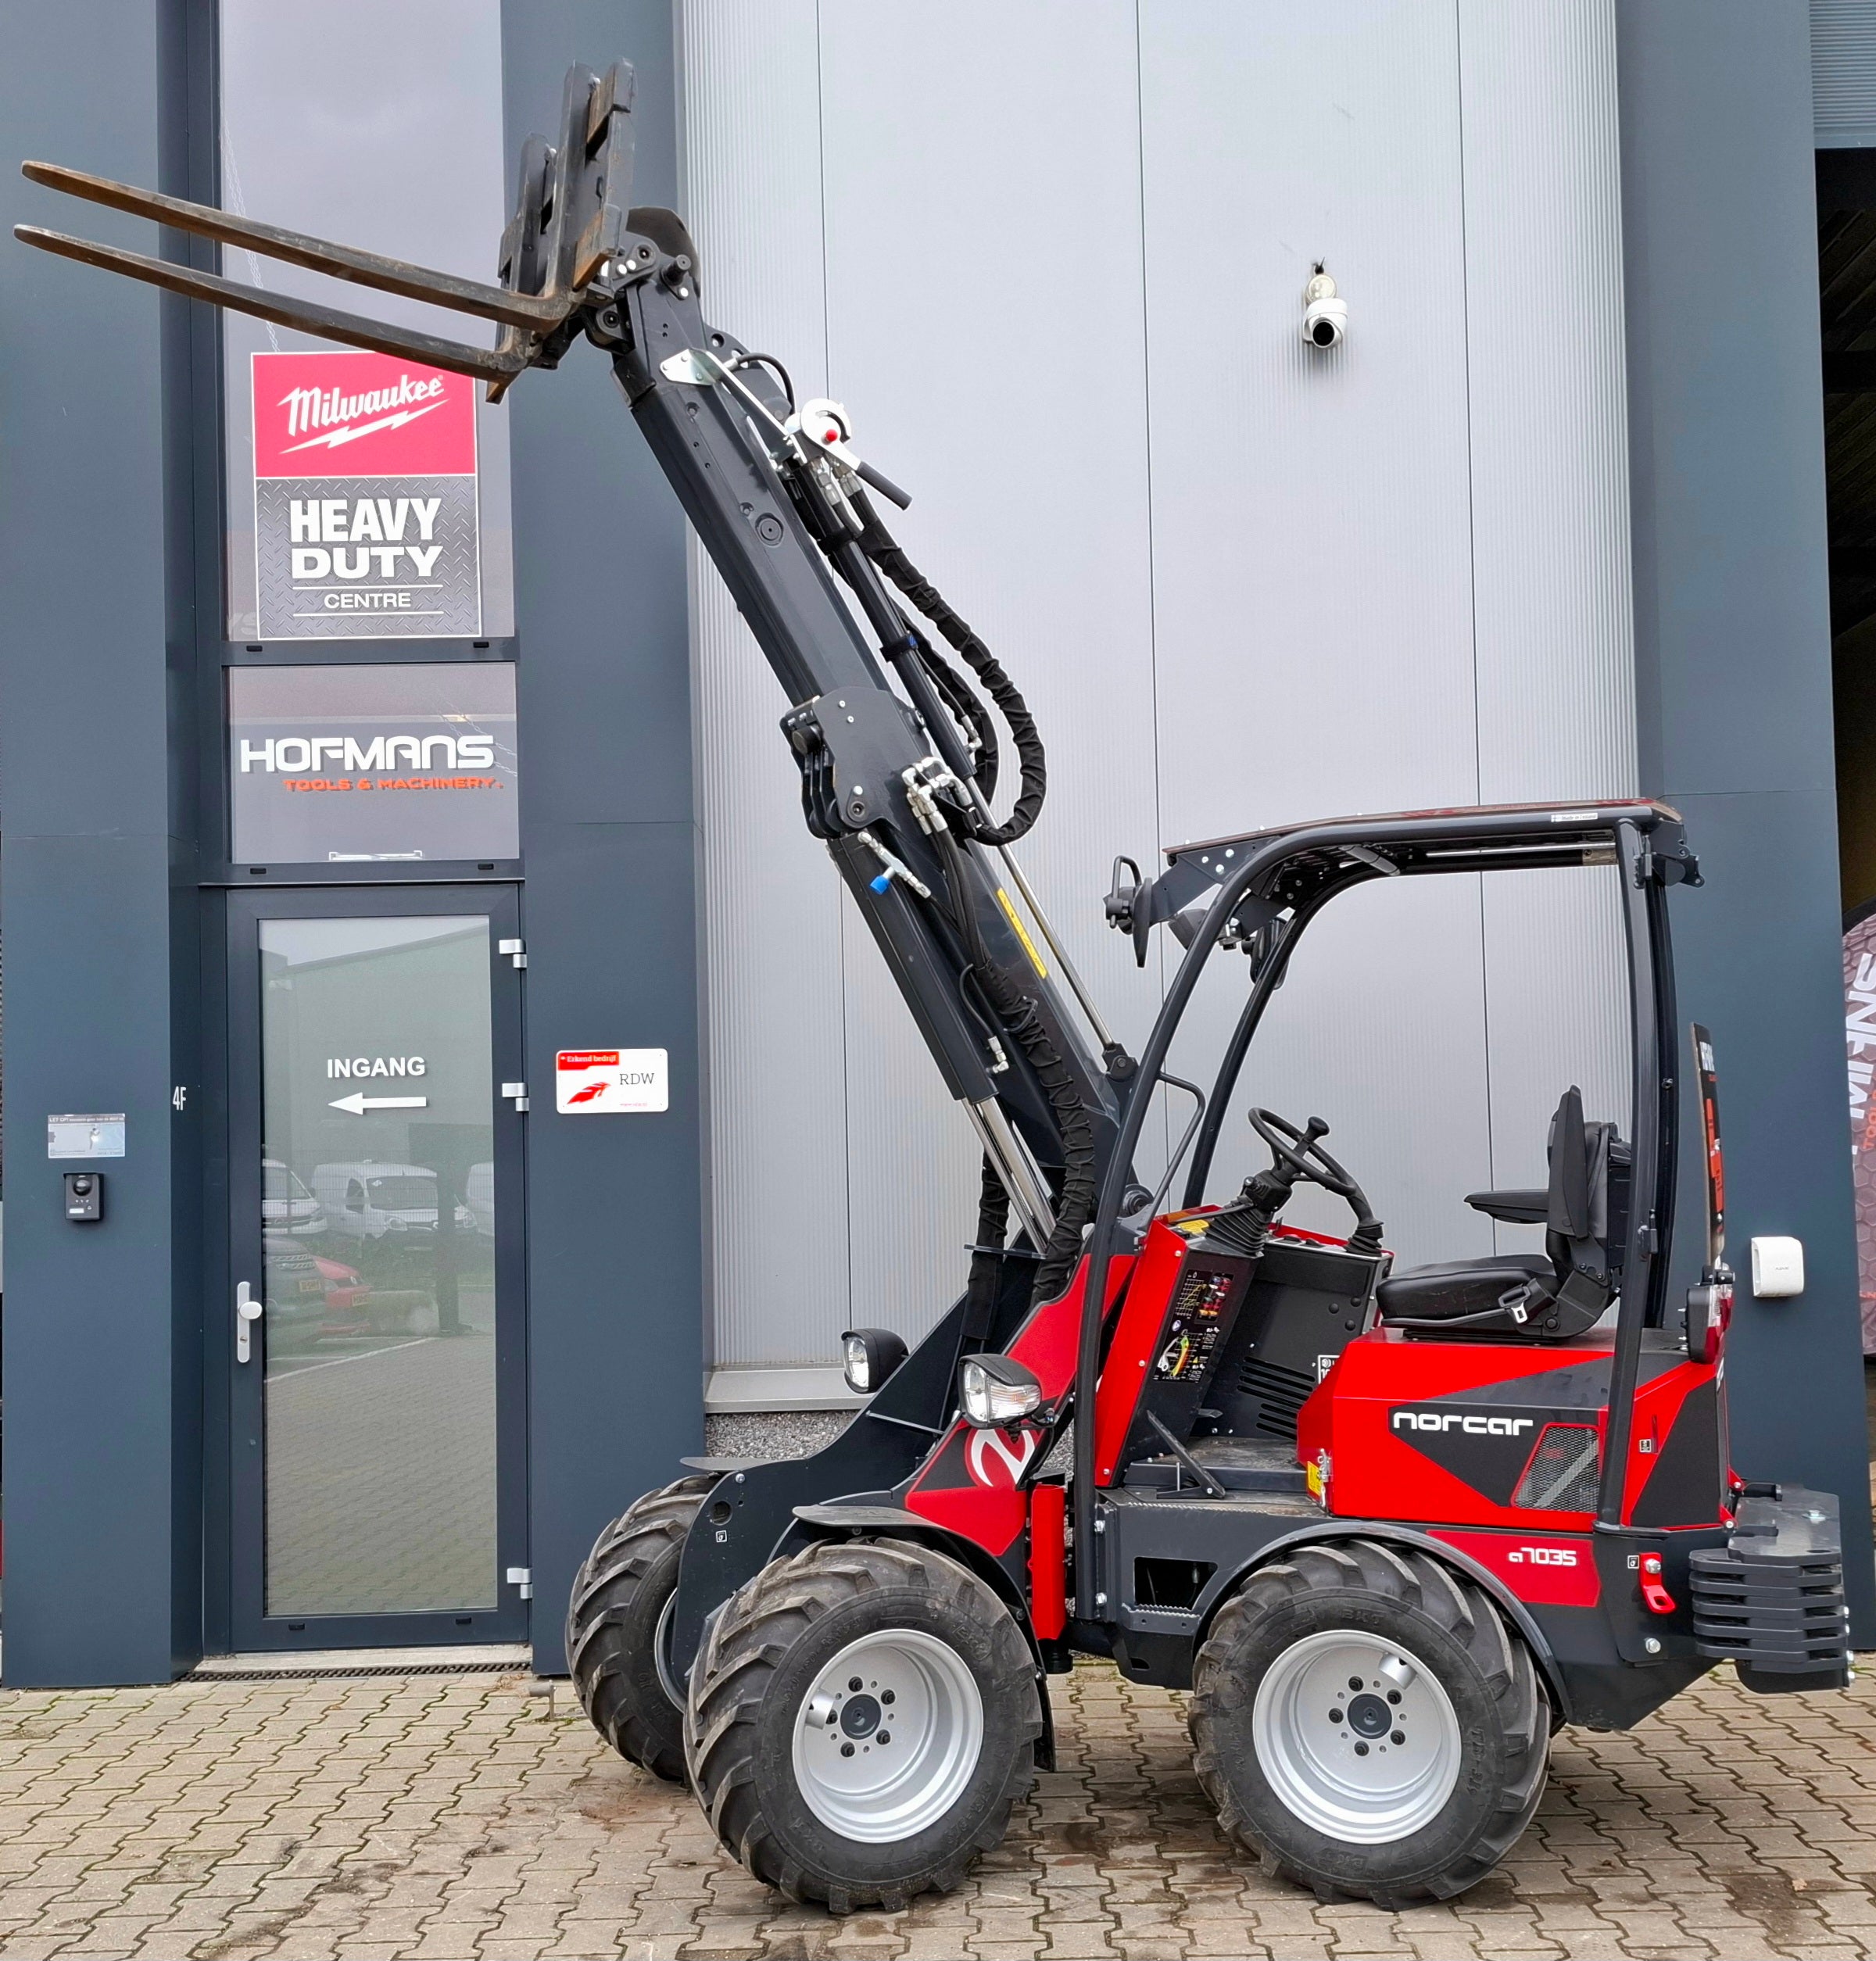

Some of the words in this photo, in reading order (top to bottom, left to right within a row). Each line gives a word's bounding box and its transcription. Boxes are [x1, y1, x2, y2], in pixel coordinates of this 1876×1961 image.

[276, 374, 444, 437] Milwaukee
[289, 498, 442, 542] HEAVY
[291, 546, 443, 579] DUTY
[324, 592, 411, 609] CENTRE
[240, 735, 494, 772] HOFMANS
[284, 778, 351, 792] TOOLS
[356, 778, 372, 791] &
[327, 1056, 426, 1078] INGANG
[619, 1072, 654, 1086] RDW
[172, 1086, 186, 1111] 4F
[1393, 1412, 1533, 1436] norcar
[1508, 1547, 1577, 1566] a7035
